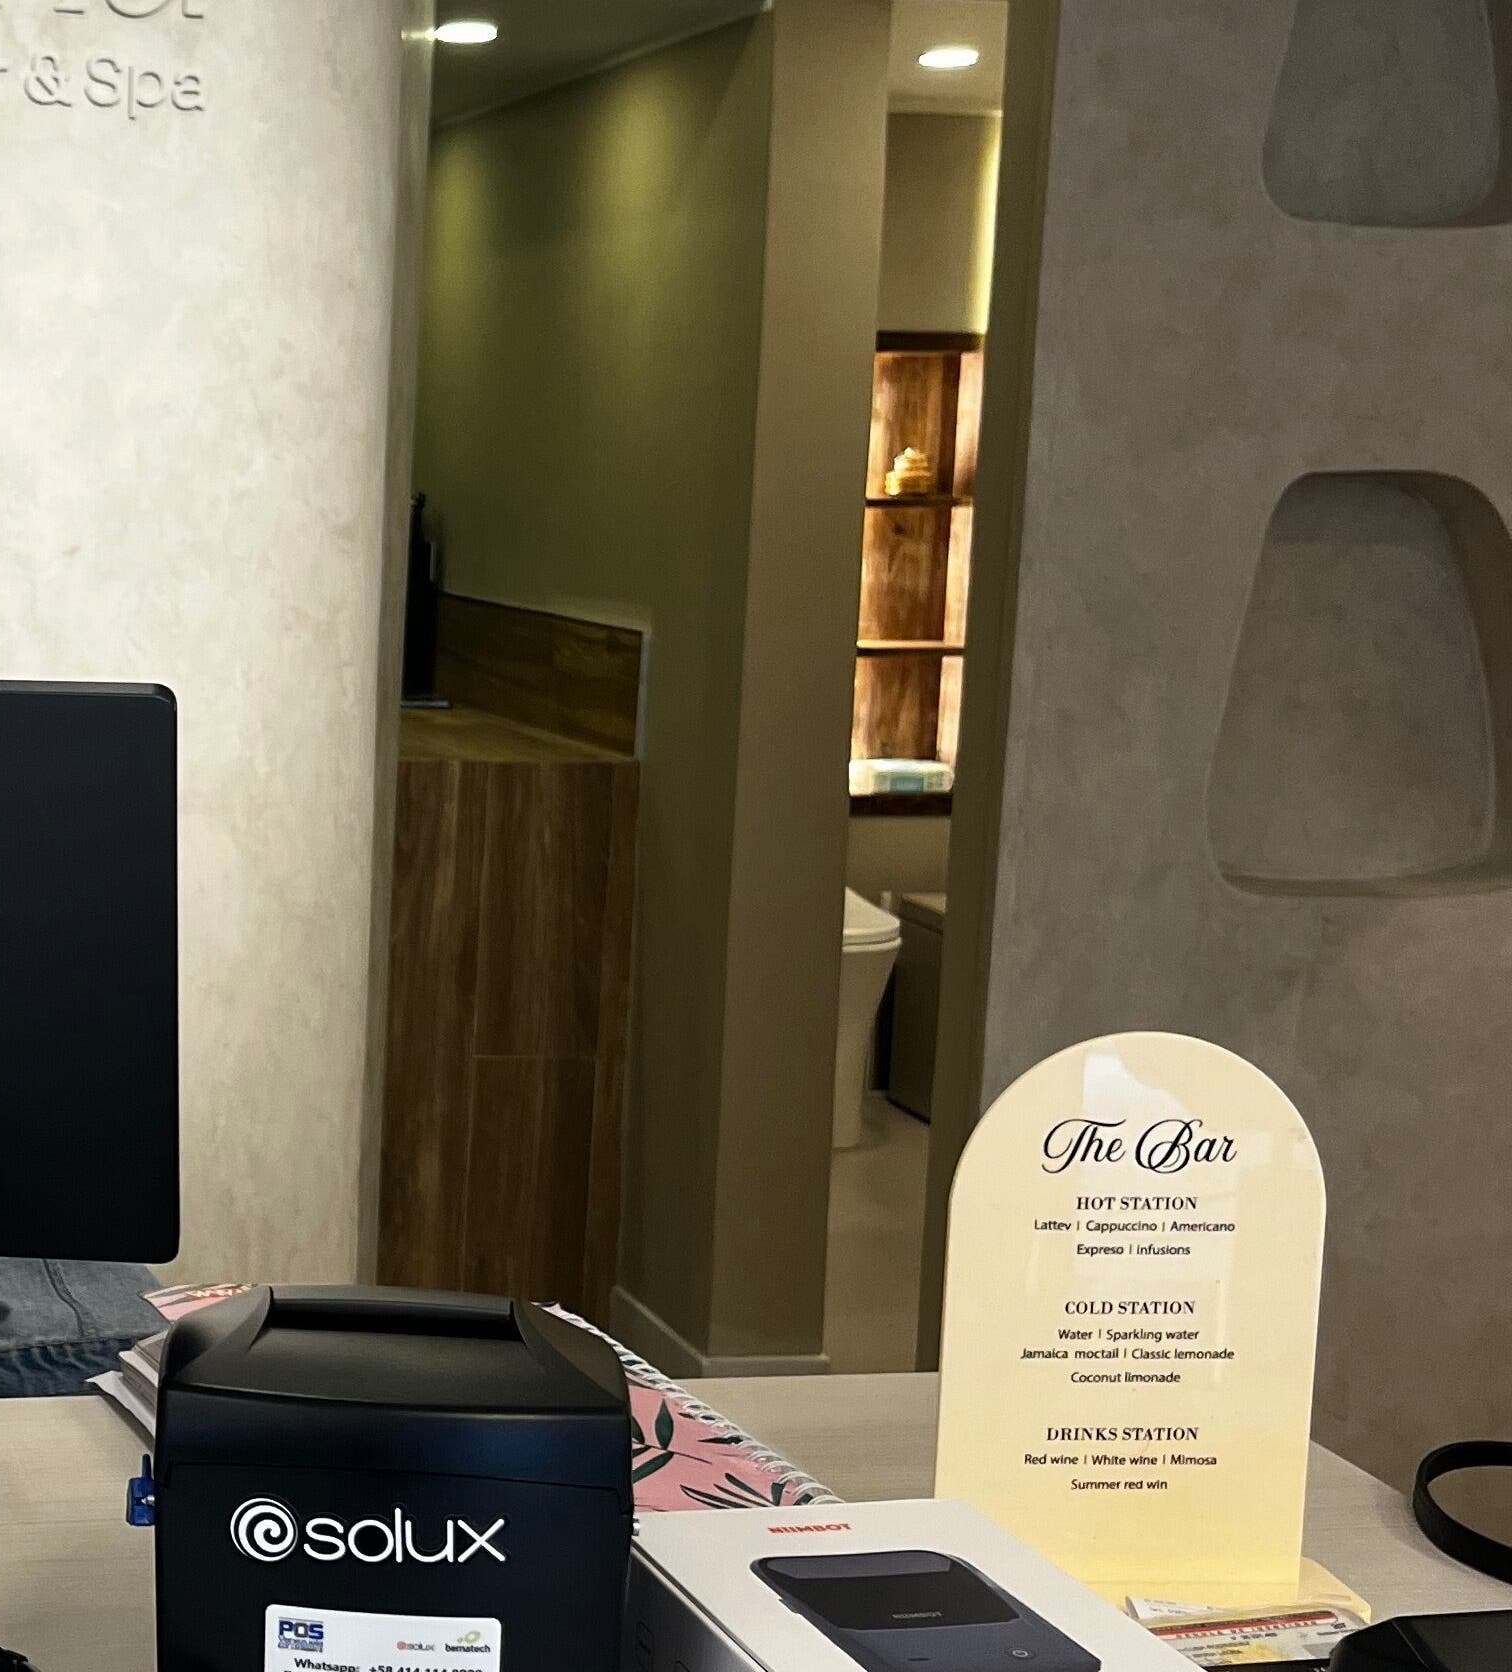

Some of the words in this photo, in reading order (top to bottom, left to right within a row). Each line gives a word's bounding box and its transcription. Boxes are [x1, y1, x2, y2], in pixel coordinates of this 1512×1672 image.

[23, 55, 72, 109] &
[83, 57, 204, 121] Spa
[1040, 1118, 1128, 1175] The
[1134, 1118, 1238, 1175] Bar
[1076, 1195, 1116, 1211] HOT
[1119, 1195, 1199, 1211] STATION
[1033, 1218, 1072, 1233] Lattev
[1085, 1219, 1158, 1235] Cappuccino
[1169, 1220, 1236, 1233] Americano
[1076, 1243, 1125, 1258] Expreso
[1064, 1300, 1114, 1316] COLD
[1117, 1300, 1196, 1316] STATION
[1057, 1328, 1094, 1341] Water
[1105, 1327, 1163, 1344] Sparkling
[1165, 1329, 1201, 1341] water
[1019, 1347, 1069, 1360] Jamaica
[1074, 1347, 1120, 1360] moctail
[1131, 1347, 1172, 1360] Classic
[1173, 1347, 1236, 1361] lemonade
[1070, 1371, 1123, 1384] Coconut
[1124, 1371, 1182, 1384] limonade
[1046, 1426, 1118, 1442] DRINKS
[1121, 1426, 1200, 1442] STATION
[1023, 1453, 1048, 1466] Red
[1049, 1453, 1080, 1466] wine
[1090, 1453, 1127, 1466] White
[1128, 1454, 1159, 1466] wine
[1169, 1453, 1218, 1466] Mimosa
[1070, 1478, 1122, 1491] Summer
[1123, 1478, 1144, 1491] red
[1146, 1479, 1168, 1490] win
[302, 1507, 507, 1564] solux
[278, 1619, 325, 1640] POS
